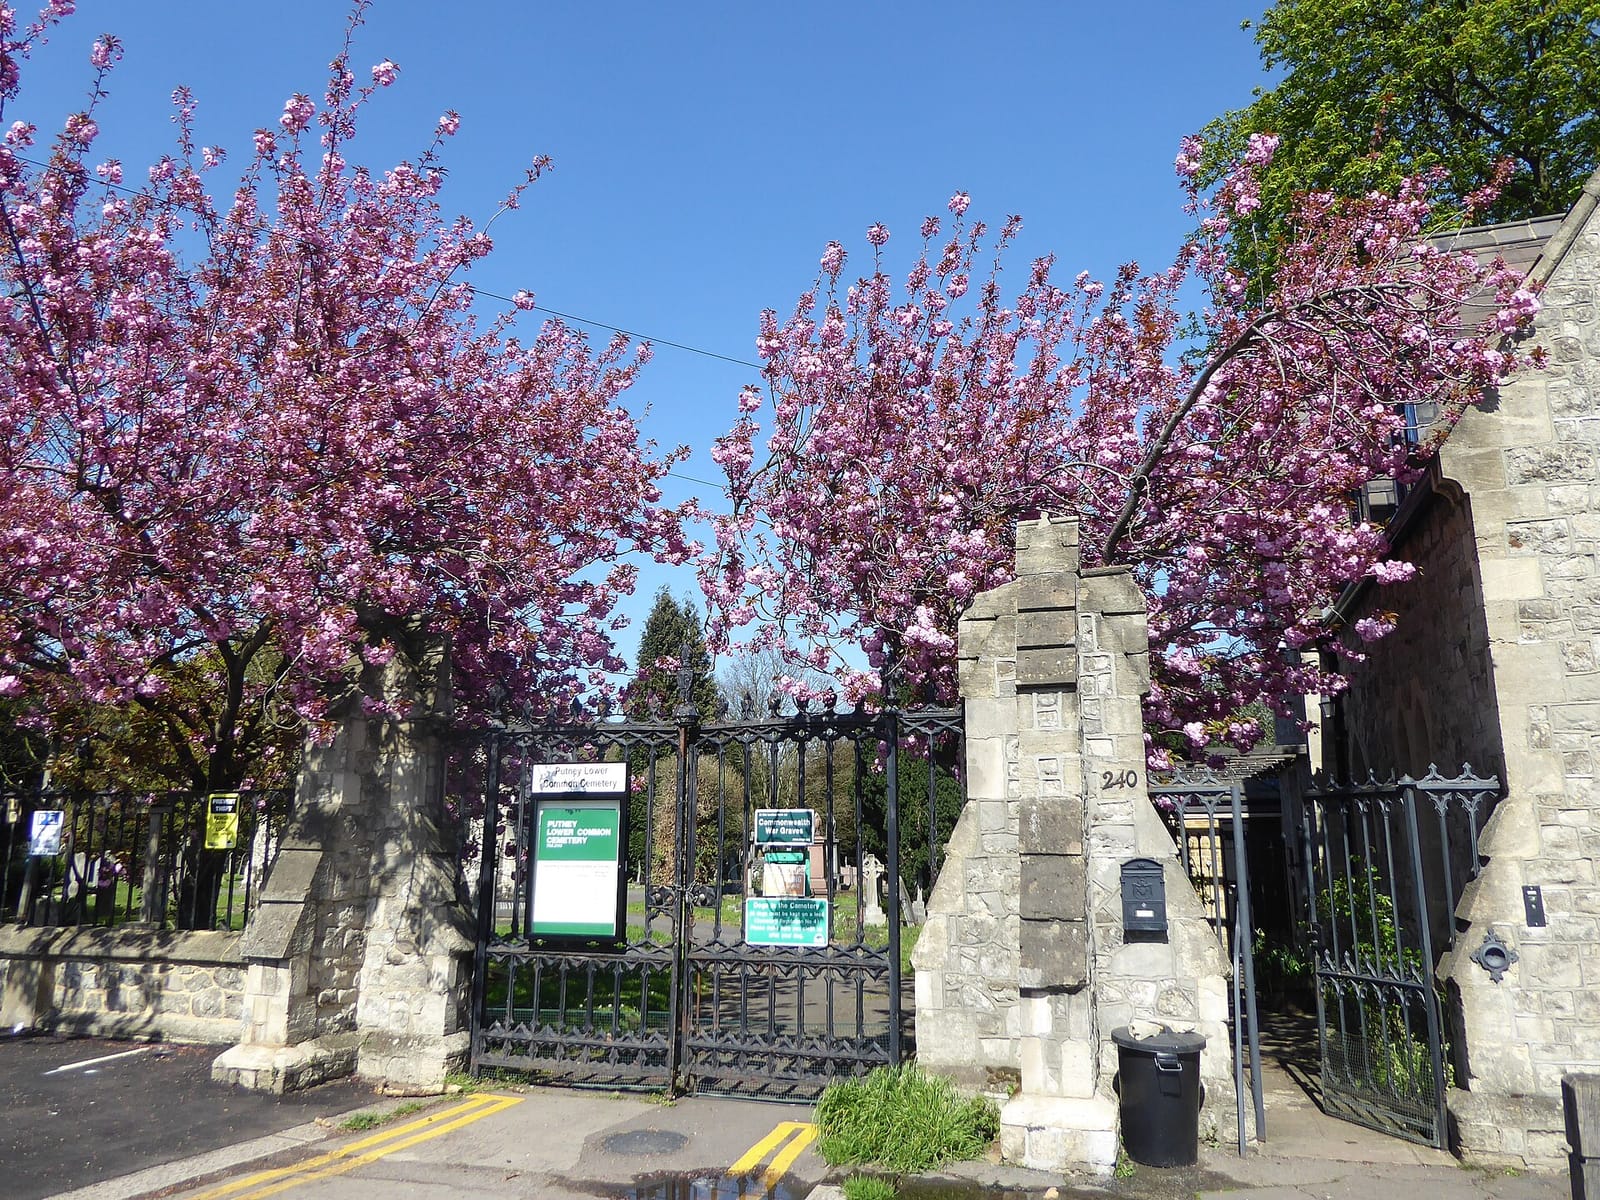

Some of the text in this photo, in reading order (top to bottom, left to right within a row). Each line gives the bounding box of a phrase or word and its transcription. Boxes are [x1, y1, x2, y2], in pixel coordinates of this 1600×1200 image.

[555, 766, 608, 776] Putney Lower
[543, 778, 617, 789] Common Cemetery
[1102, 769, 1138, 790] 240
[547, 820, 577, 828] PUTNEY
[758, 818, 811, 826] Commonwealth
[546, 828, 612, 836] LOWER COMMON
[765, 826, 804, 835] War Graves
[546, 836, 588, 844] CEMETERY
[790, 902, 820, 911] Cemetery
